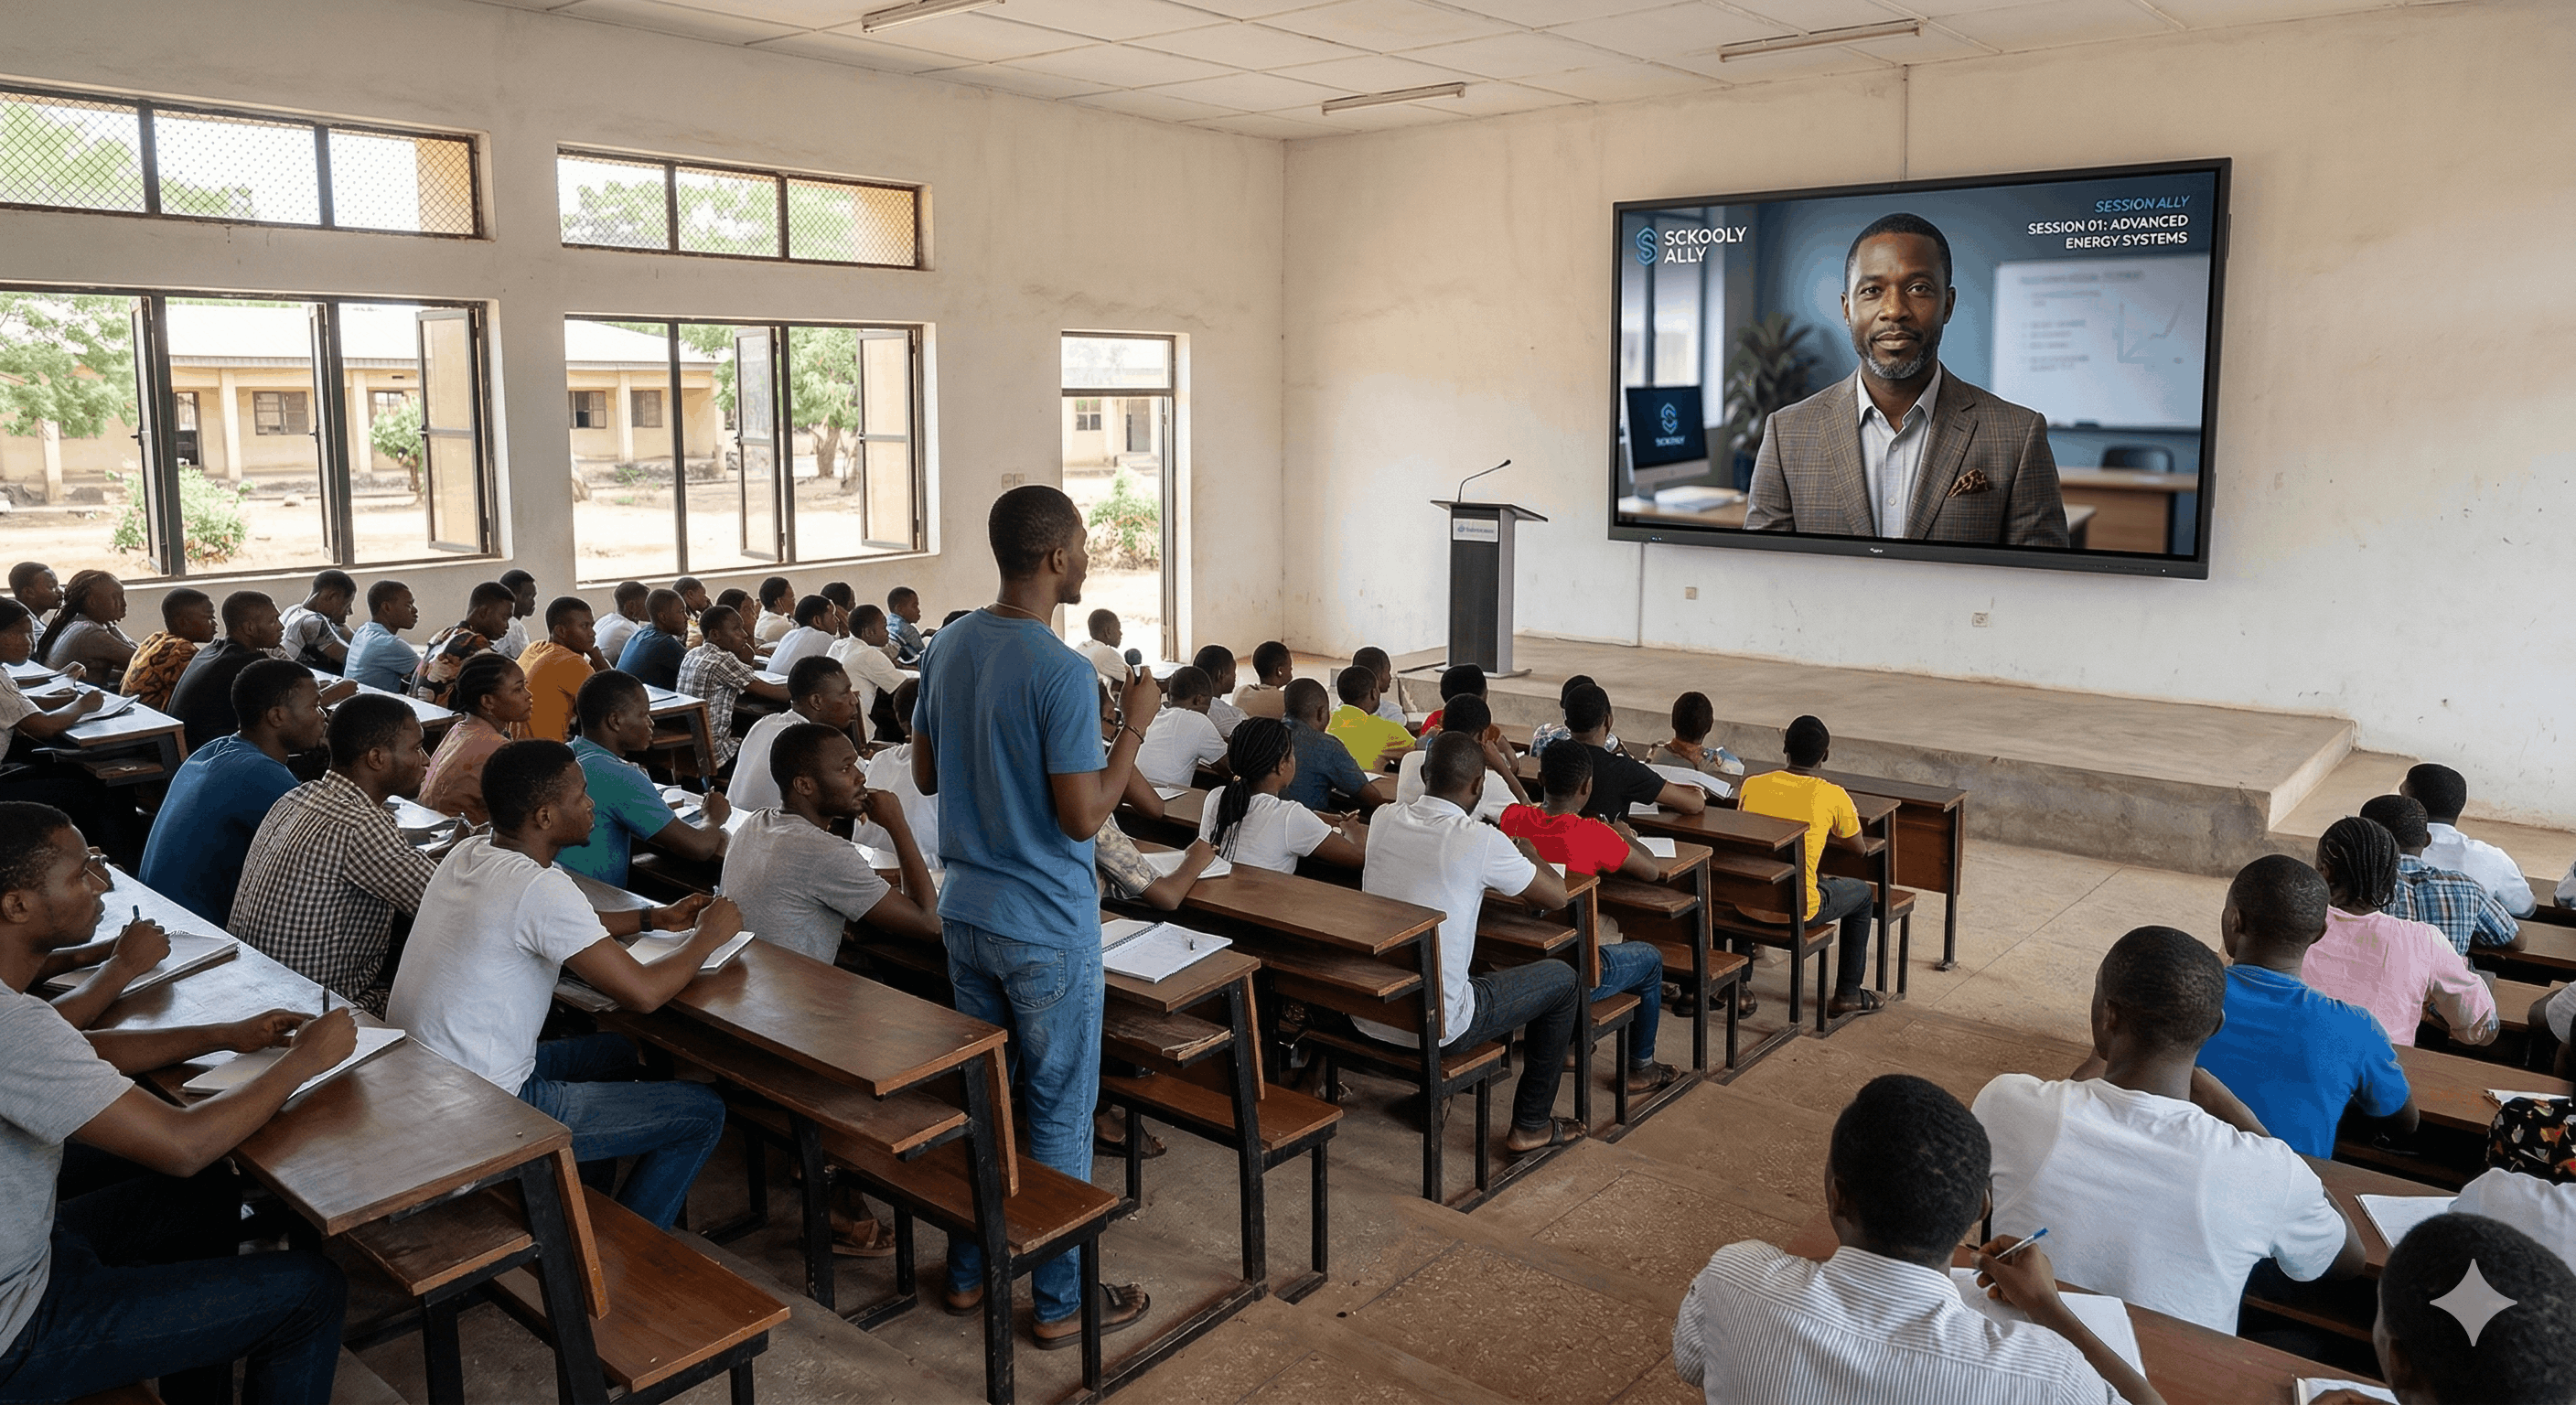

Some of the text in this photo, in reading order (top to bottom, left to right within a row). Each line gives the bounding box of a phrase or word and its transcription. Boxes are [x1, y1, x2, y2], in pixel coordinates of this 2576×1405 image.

[2095, 195, 2190, 213] SESSION ALLY
[2027, 214, 2189, 235] SESSION 01: ADVANCED
[1664, 226, 1747, 246] SCKOOLY
[2066, 231, 2188, 249] ENERGY SYSTEMS
[1664, 246, 1707, 263] ALLY
